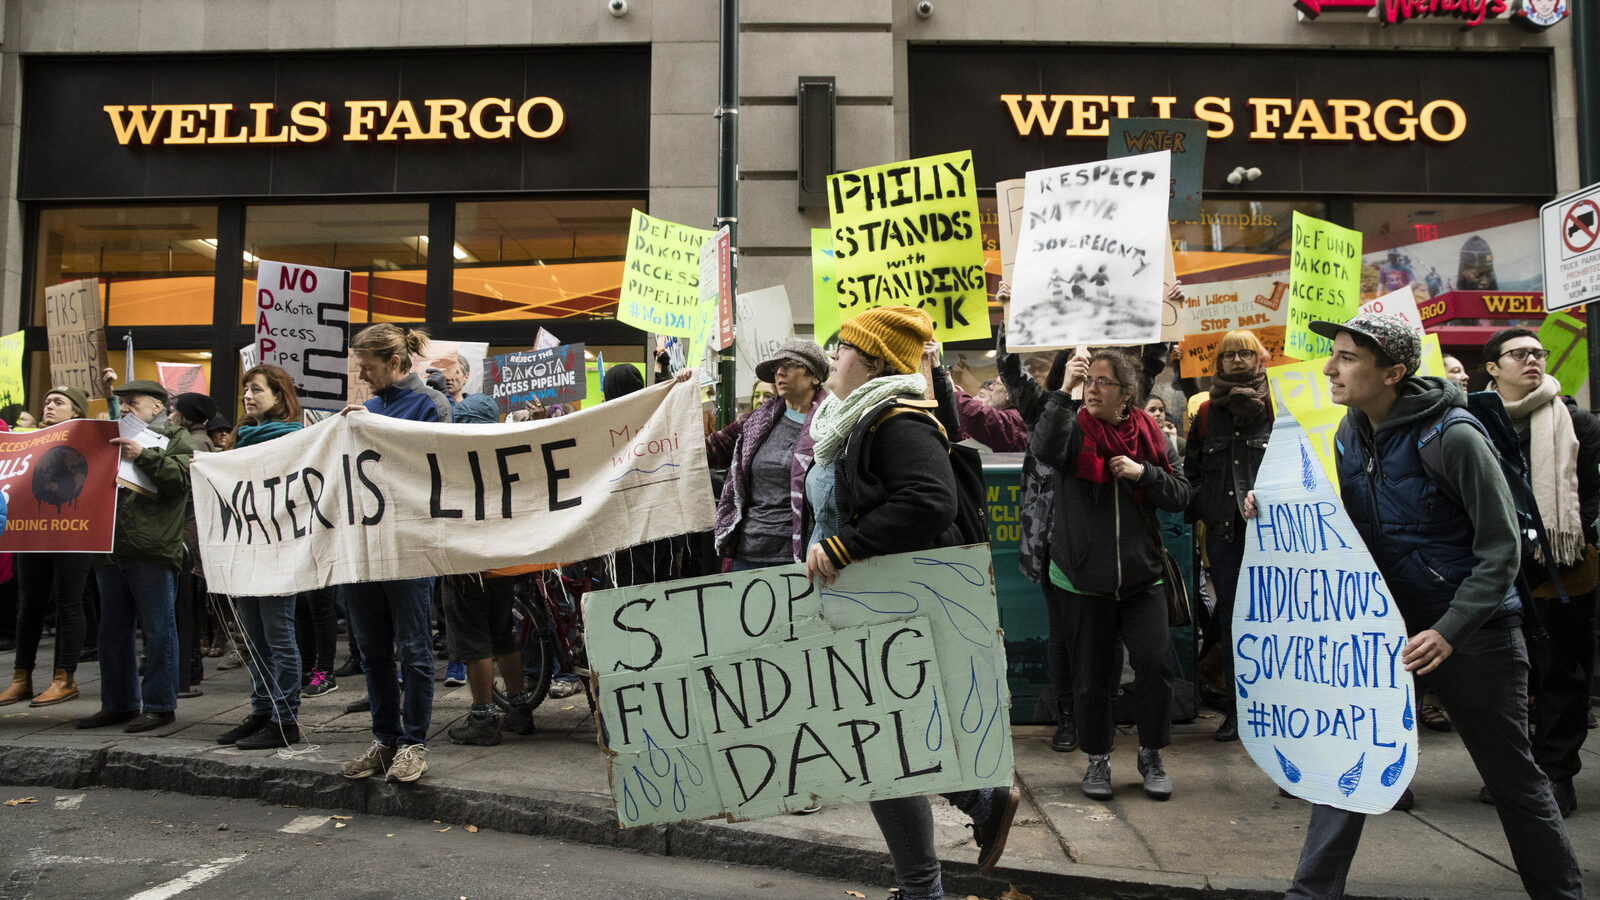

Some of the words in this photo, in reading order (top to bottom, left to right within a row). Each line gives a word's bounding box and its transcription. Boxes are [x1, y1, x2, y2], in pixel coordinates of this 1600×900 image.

[1385, 0, 1507, 26] Wendys
[103, 101, 329, 145] WELLS
[343, 96, 565, 141] FARGO
[1248, 97, 1467, 142] FARGO
[1123, 129, 1187, 154] WATER
[832, 159, 971, 214] PHILLY
[1040, 164, 1156, 194] RESPECT
[1029, 200, 1120, 230] NATIVE
[835, 211, 973, 259] STANDS
[631, 259, 700, 287] ACCESS
[887, 252, 926, 270] with
[1294, 251, 1349, 281] DAKOTA
[279, 265, 318, 293] NO
[837, 265, 984, 308] STANDING
[1292, 281, 1345, 306] ACCESS
[47, 288, 88, 328] FIRST
[1201, 318, 1231, 332] STOP
[1238, 313, 1270, 327] DAPL
[257, 311, 317, 342] Access
[51, 330, 97, 364] NATIONS
[510, 355, 537, 363] REJECT
[537, 349, 554, 360] THE
[52, 366, 102, 397] MATTER
[493, 381, 529, 398] ACCESS
[531, 370, 576, 390] PIPELINE
[501, 357, 566, 383] DAKOTA
[0, 439, 31, 453] CCESS
[207, 467, 334, 545] WATER
[343, 449, 385, 525] IS
[426, 438, 582, 521] LIFE
[51, 520, 89, 531] ROCK
[1254, 501, 1353, 554] HONOR
[1244, 565, 1390, 624] INDIGENOUS
[612, 573, 815, 673] STOP
[1236, 631, 1405, 690] SOVEREIGNTY
[612, 627, 932, 746] FUNDING
[719, 709, 943, 808] DAPL
